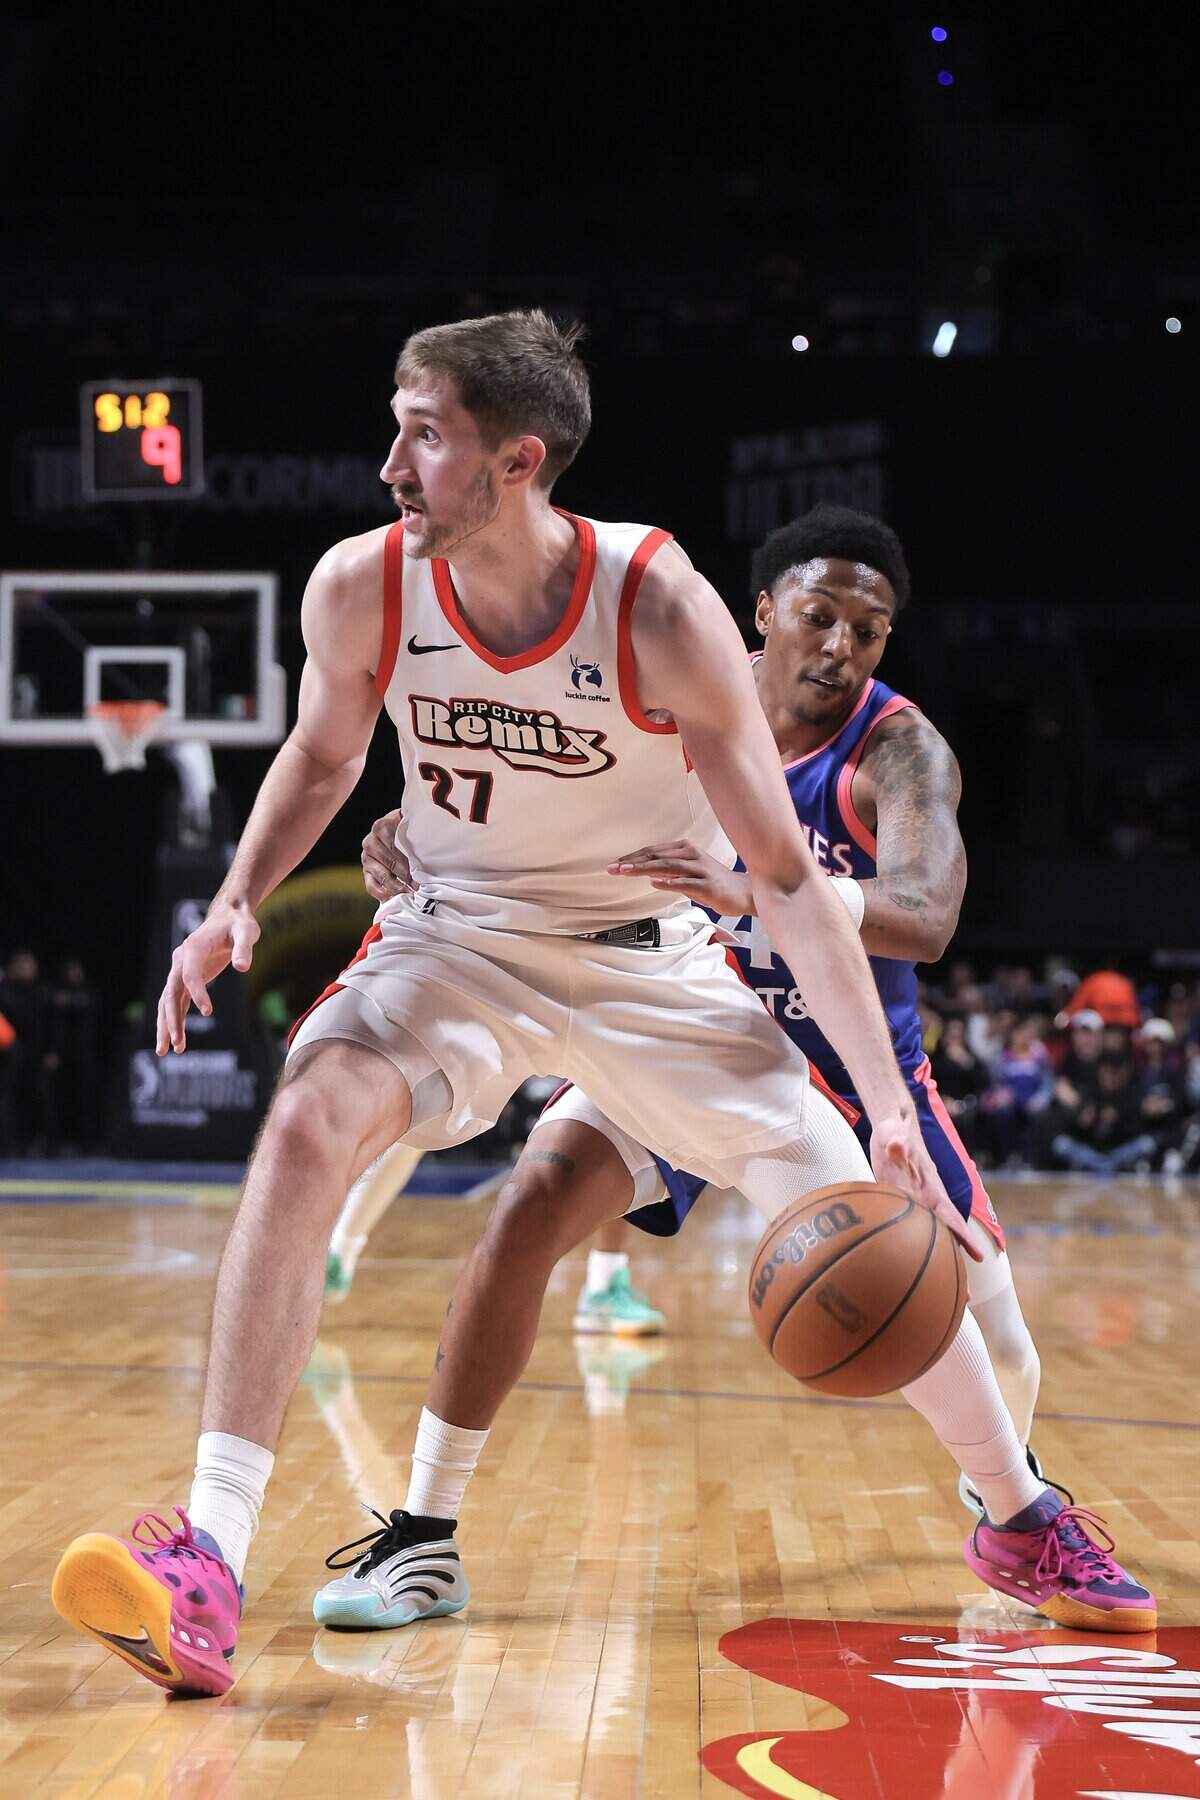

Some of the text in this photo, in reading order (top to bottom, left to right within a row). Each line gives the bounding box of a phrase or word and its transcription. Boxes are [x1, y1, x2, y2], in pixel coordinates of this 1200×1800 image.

[141, 424, 182, 485] 9
[453, 701, 535, 723] RIP CITY
[565, 691, 587, 700] luckin
[411, 696, 613, 776] Remix
[418, 762, 493, 824] 27
[752, 1202, 864, 1310] Wilson
